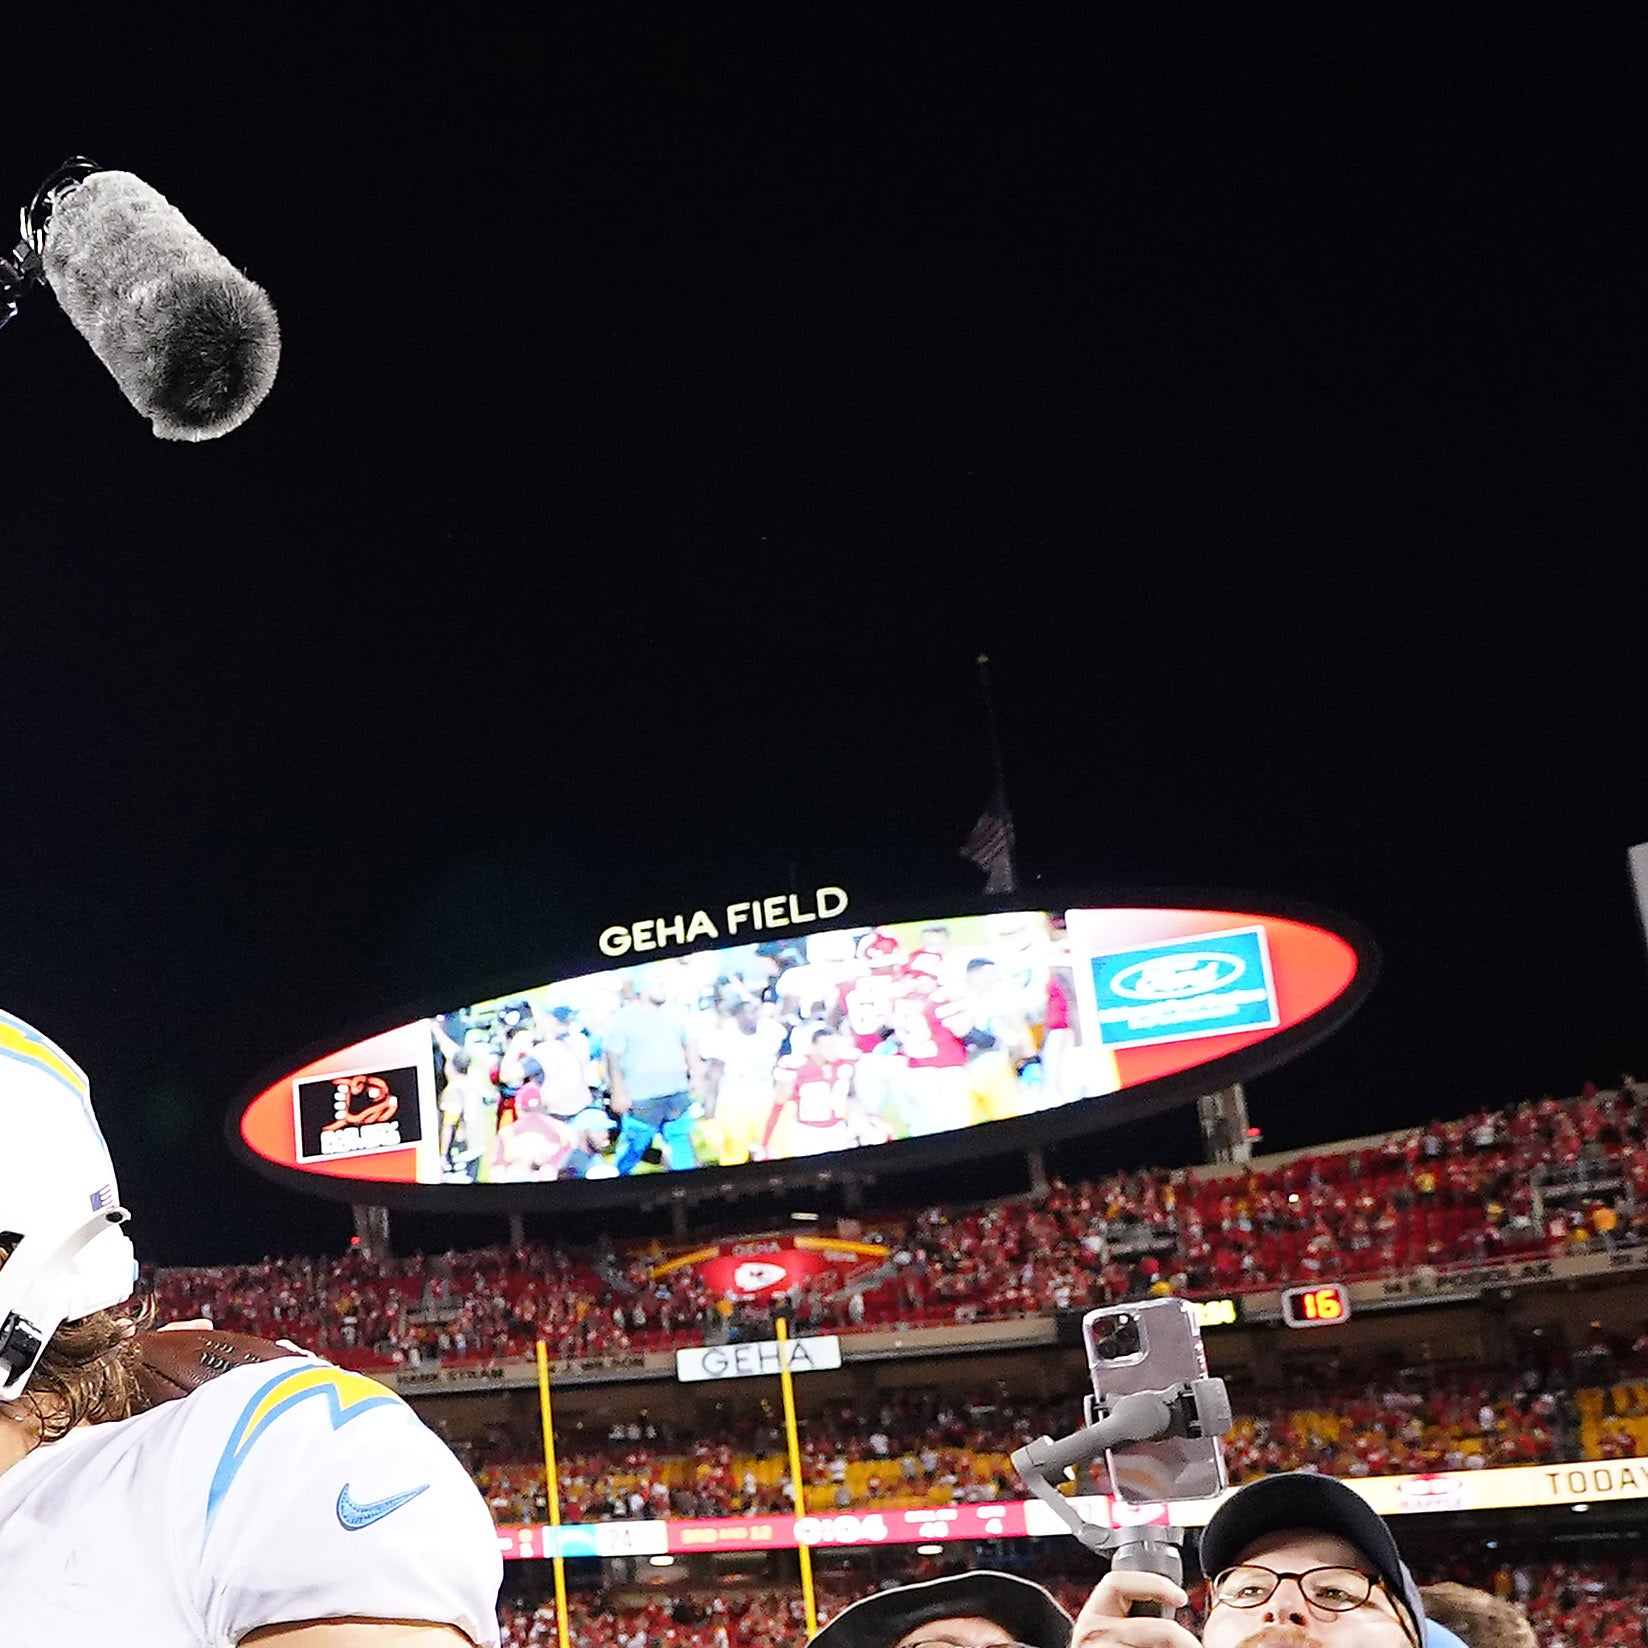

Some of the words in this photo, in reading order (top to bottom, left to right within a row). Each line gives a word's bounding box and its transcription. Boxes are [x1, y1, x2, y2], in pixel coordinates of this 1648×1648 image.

[598, 910, 719, 957] GEHA
[726, 886, 849, 936] FIELD
[701, 1340, 815, 1378] GEHA
